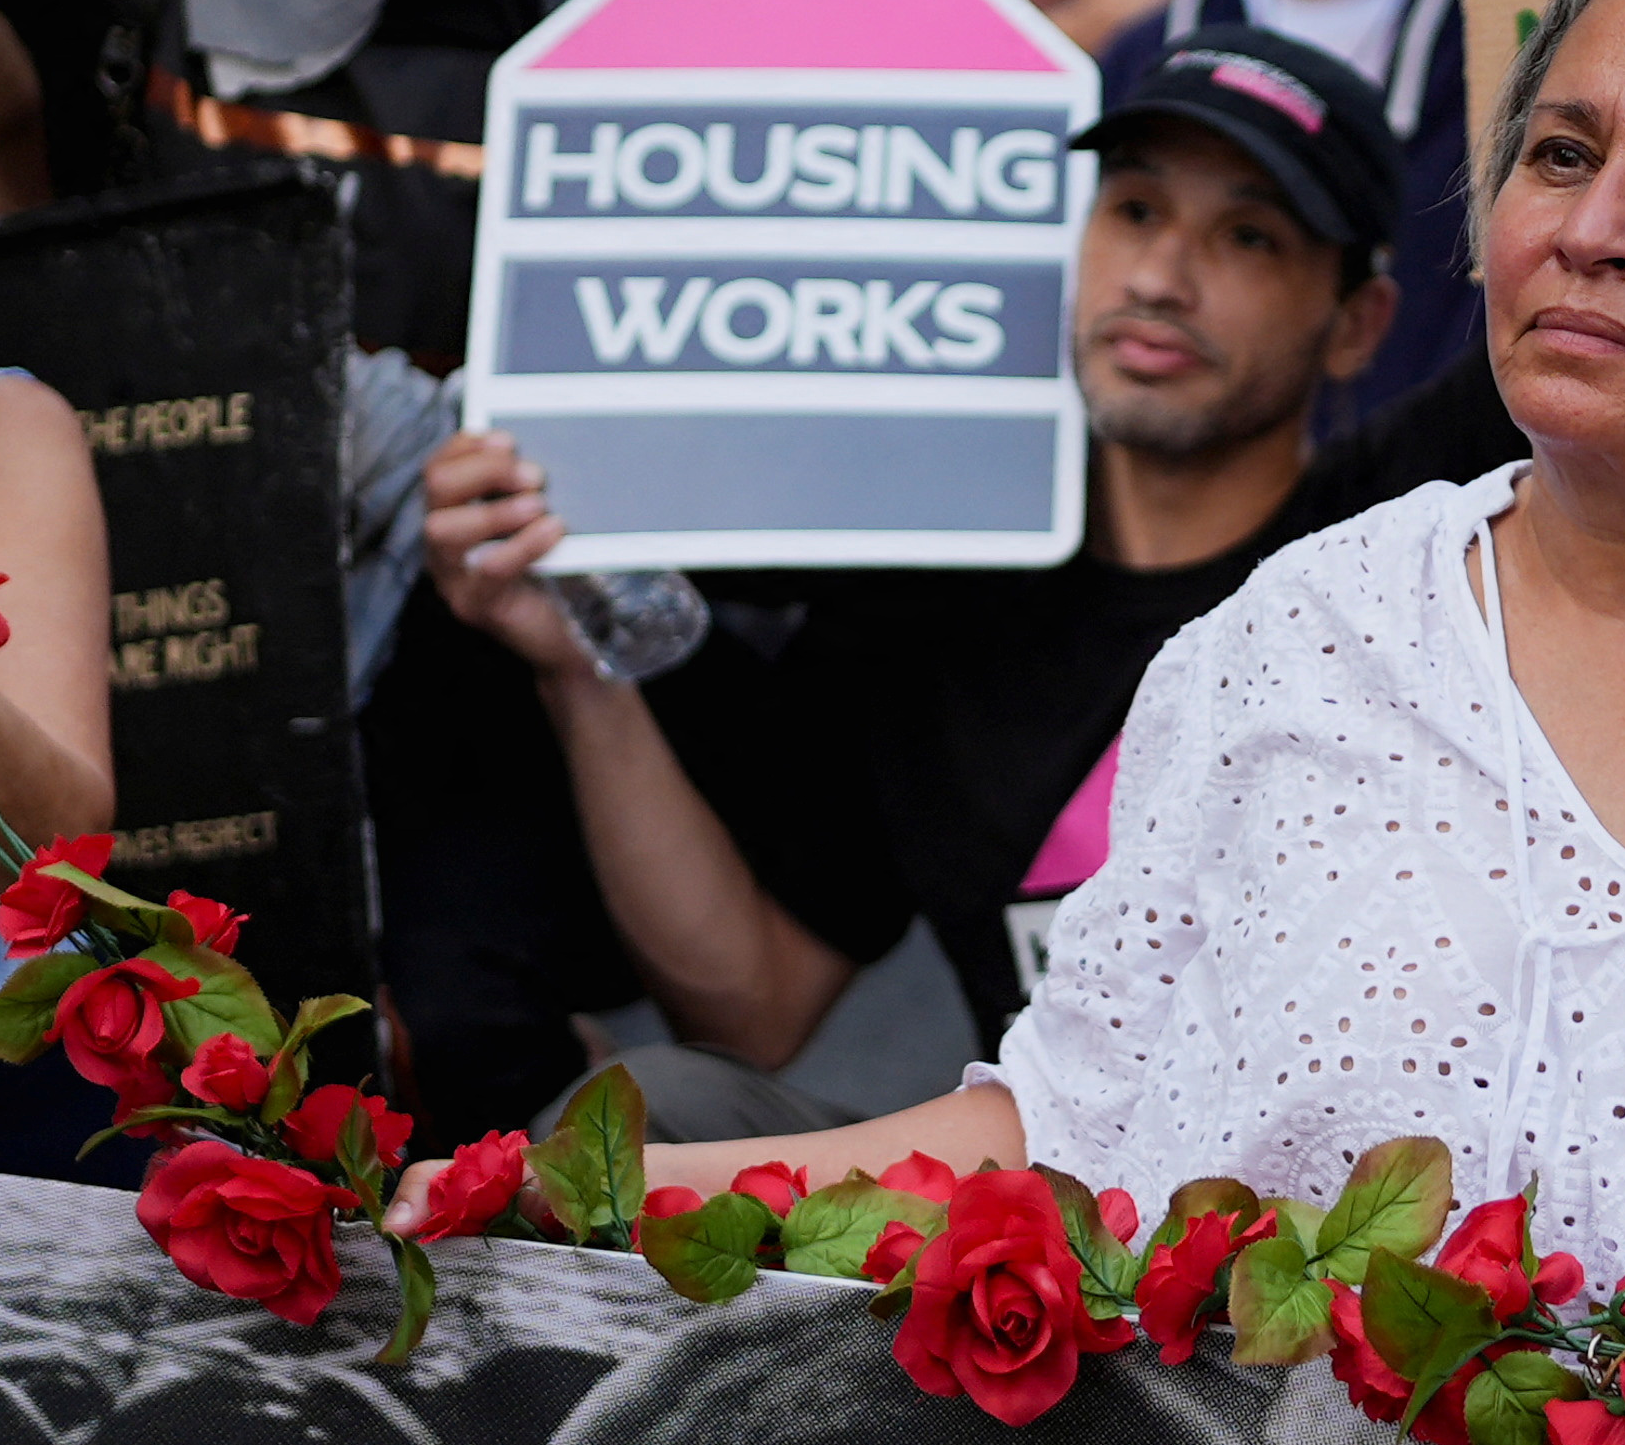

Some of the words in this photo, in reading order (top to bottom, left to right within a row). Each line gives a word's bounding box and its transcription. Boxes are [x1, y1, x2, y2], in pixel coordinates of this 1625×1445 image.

[521, 121, 1060, 217] HOUSING
[574, 275, 1006, 368] WORKS
[132, 390, 254, 452] PEOPLE
[113, 577, 231, 640] THINGS
